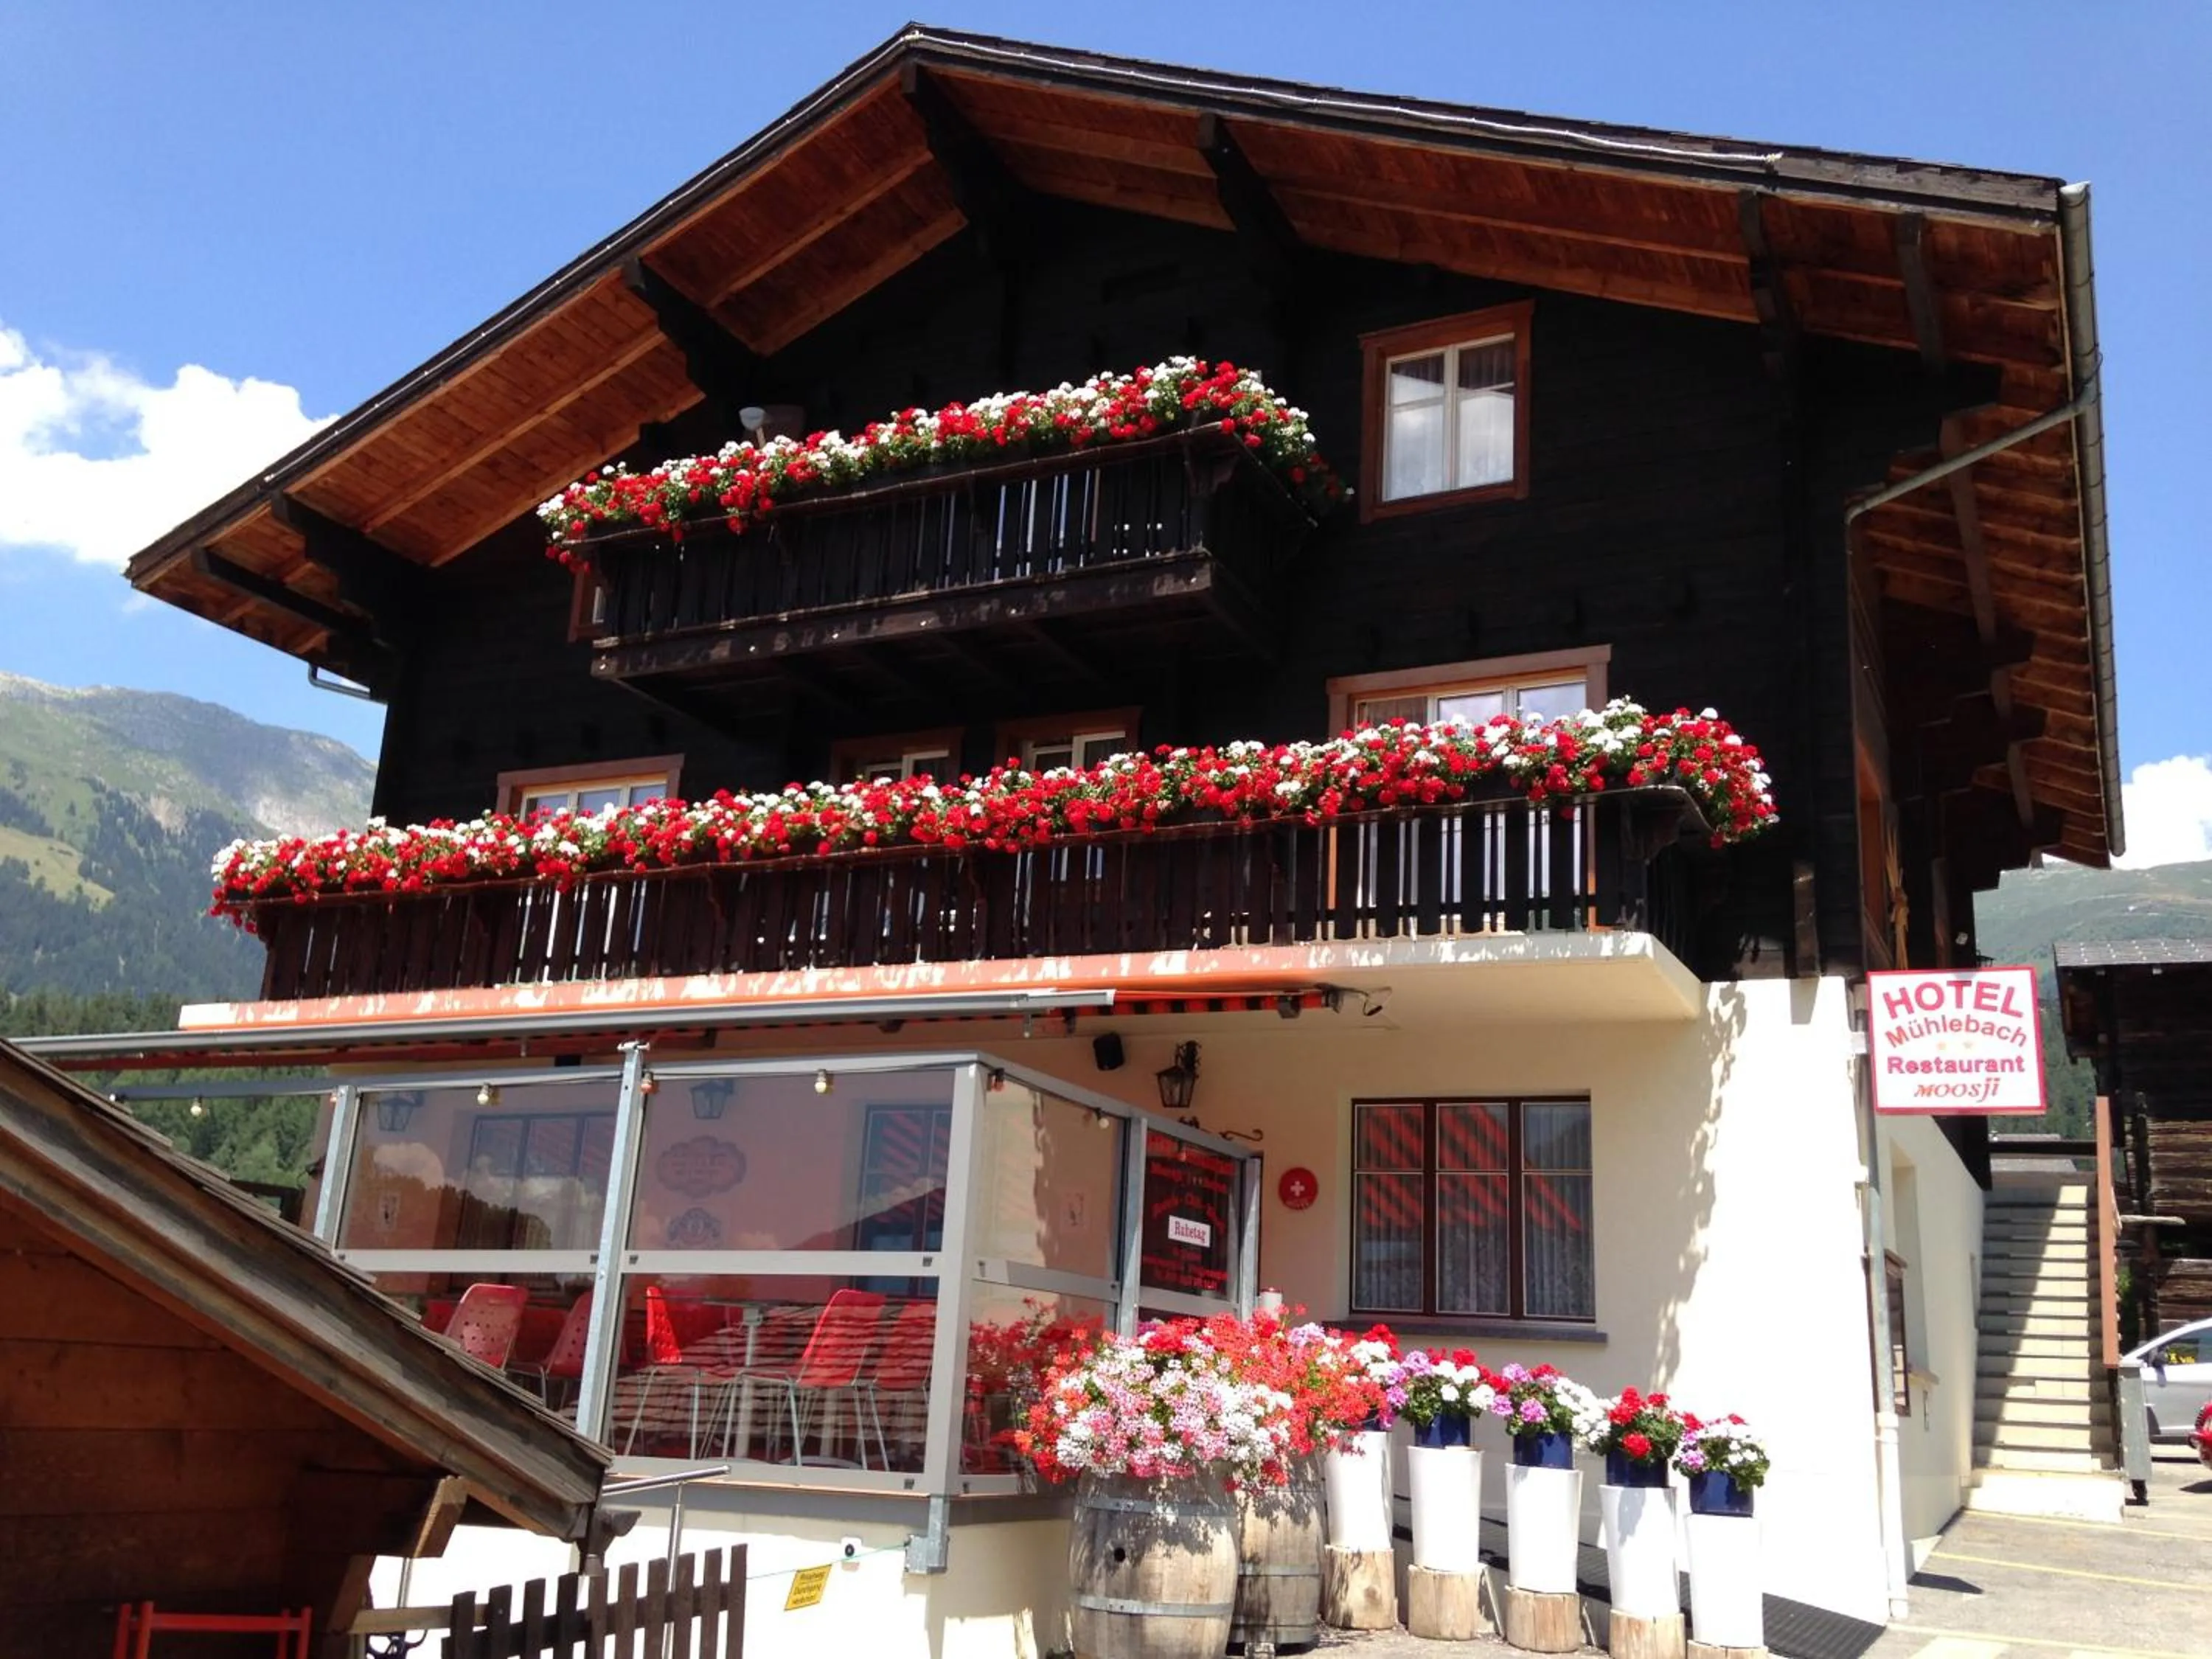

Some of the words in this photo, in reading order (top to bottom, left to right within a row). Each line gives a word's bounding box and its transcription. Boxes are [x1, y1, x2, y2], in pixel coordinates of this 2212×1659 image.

[1882, 980, 2024, 1020] HOTEL
[1885, 1015, 2027, 1048] Mühlebach
[1887, 1055, 2025, 1074] Restaurant
[1175, 1220, 1206, 1244] Ruhetag
